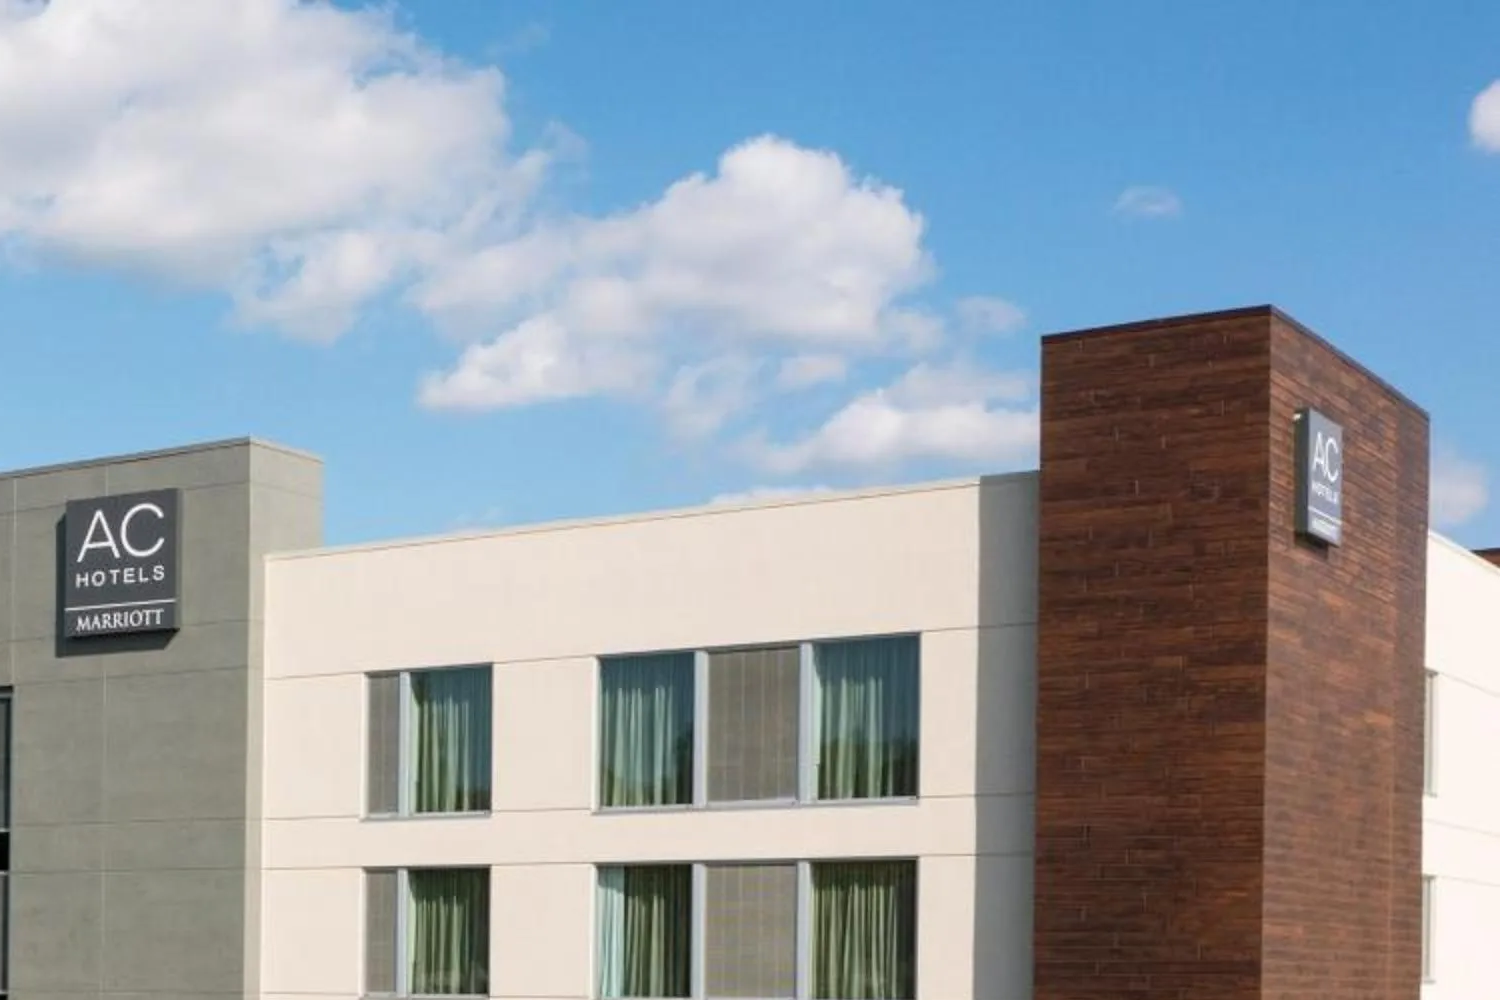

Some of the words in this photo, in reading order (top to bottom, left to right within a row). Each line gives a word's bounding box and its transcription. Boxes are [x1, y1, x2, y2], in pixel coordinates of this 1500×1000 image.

[1312, 431, 1339, 483] AC
[76, 503, 165, 563] AC
[75, 565, 165, 588] HOTELS
[76, 608, 165, 632] MARRIOTT
